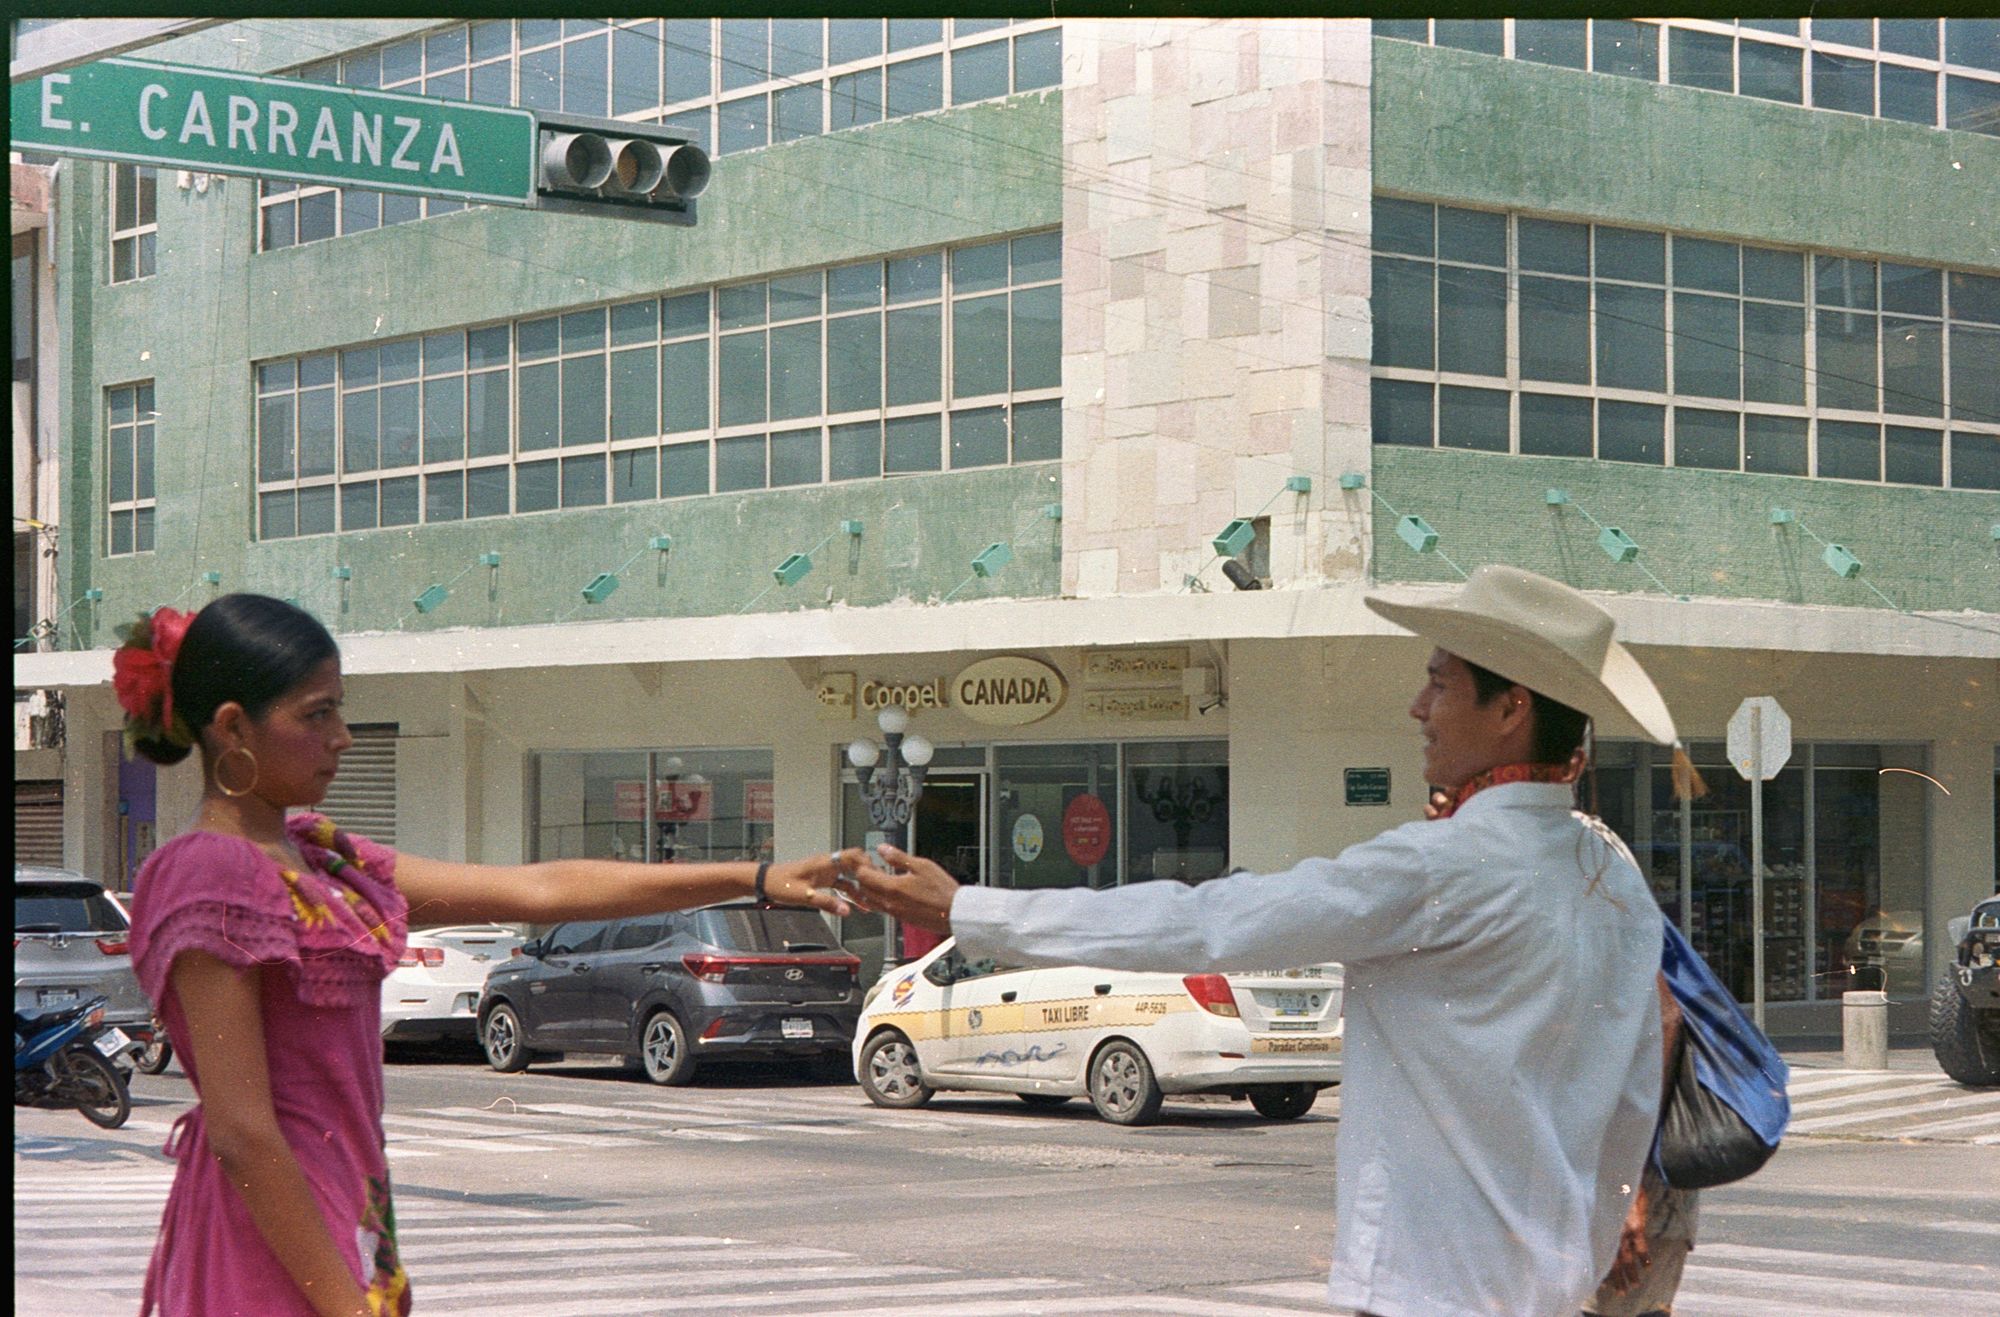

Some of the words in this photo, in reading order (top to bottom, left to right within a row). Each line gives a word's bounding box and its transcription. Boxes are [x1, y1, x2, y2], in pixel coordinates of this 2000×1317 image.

[41, 73, 90, 132] E.
[138, 84, 465, 177] CARRANZA
[961, 677, 1051, 705] CANADA
[1042, 1008, 1062, 1024] TAXI
[1064, 1005, 1089, 1022] LIBRE
[1268, 1041, 1296, 1052] Paradas
